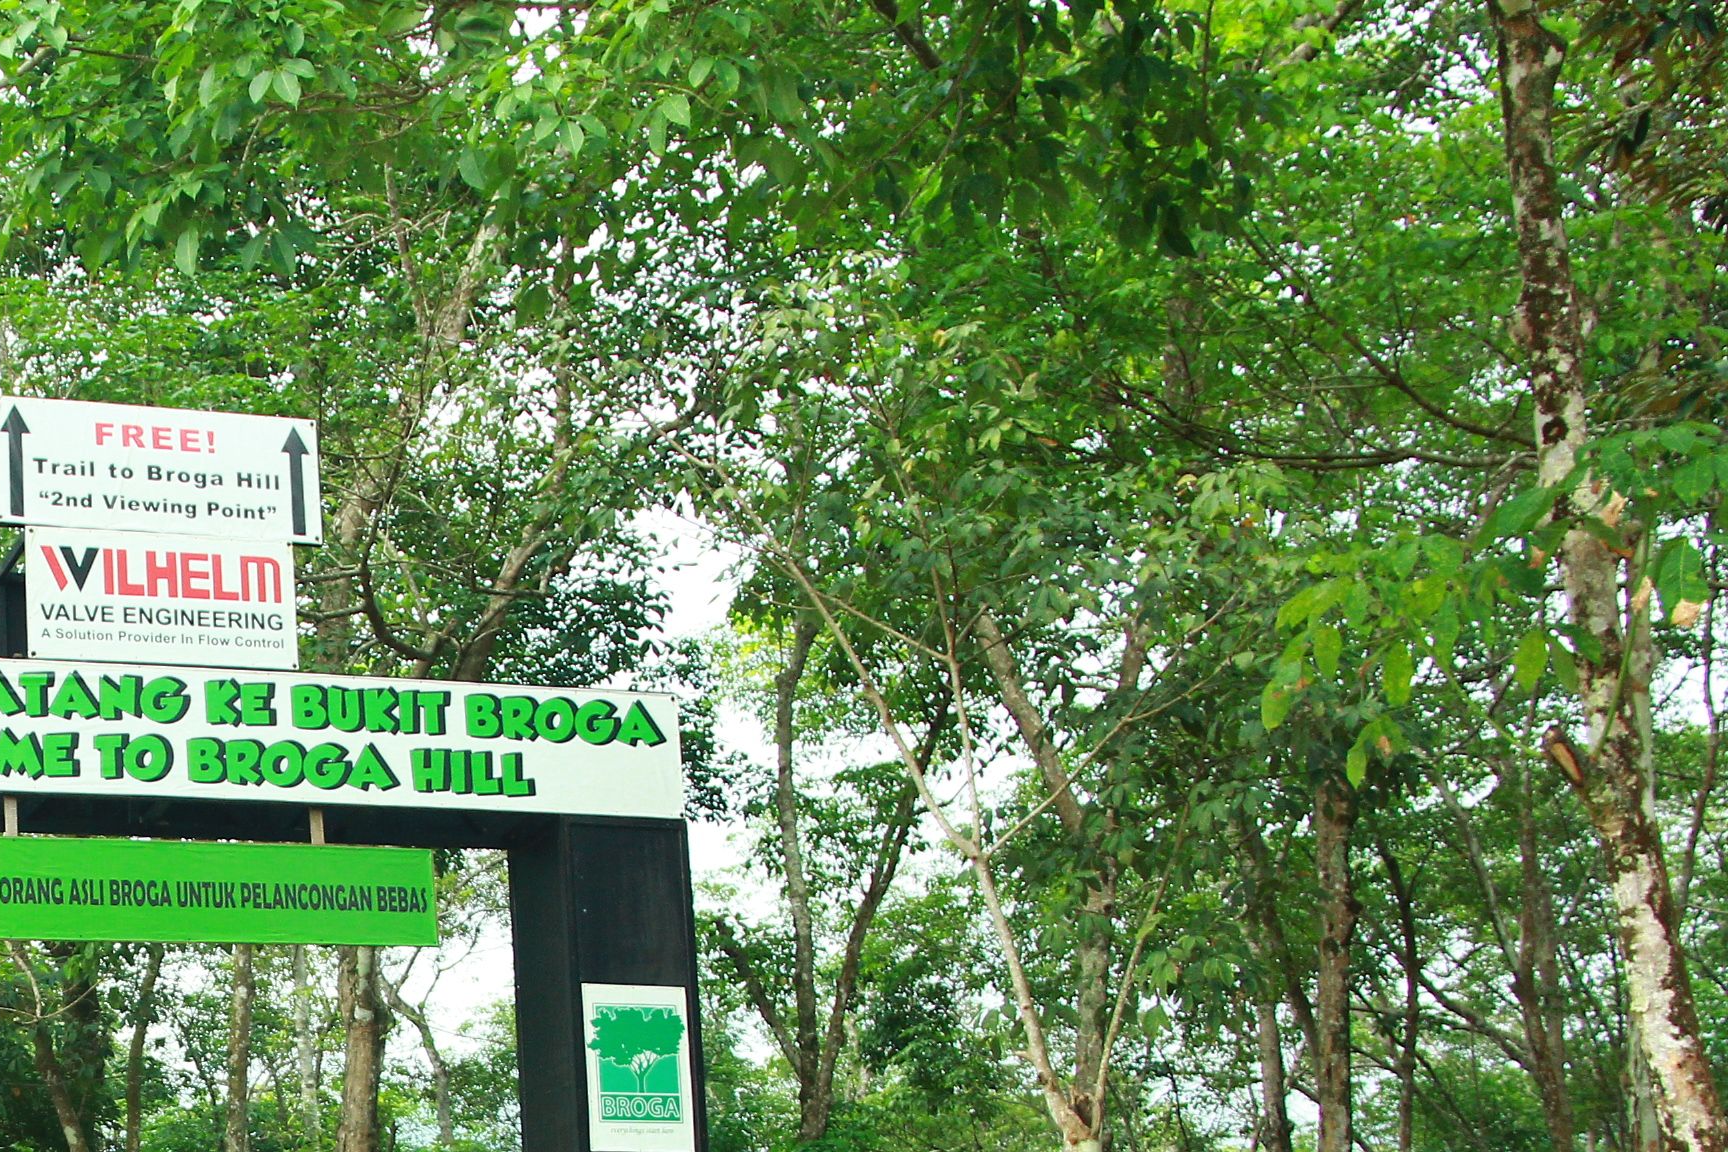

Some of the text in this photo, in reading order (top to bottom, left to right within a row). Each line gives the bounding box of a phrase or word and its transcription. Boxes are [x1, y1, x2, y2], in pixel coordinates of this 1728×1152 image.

[95, 422, 216, 454] FREE!
[33, 458, 279, 490] Trail to Broga Hill
[103, 494, 197, 519] Viewing
[41, 546, 281, 603] WILHELM
[40, 603, 283, 631] VALVE ENGINEERING
[41, 628, 284, 650] A Solution Provider In Flow Control
[204, 678, 277, 728] KE
[290, 684, 451, 736] BUKIT
[464, 693, 667, 747] BROGA
[93, 733, 174, 782] TO
[186, 737, 401, 792] BROGA
[410, 748, 536, 798] HILL
[0, 877, 64, 905] ORANG
[69, 879, 104, 905] ASLI
[110, 880, 172, 906] BROGA
[177, 882, 236, 908] UNTUK
[241, 883, 372, 911] PELANCONGAN
[377, 886, 427, 913] BEBAS
[602, 1096, 680, 1118] BROGA
